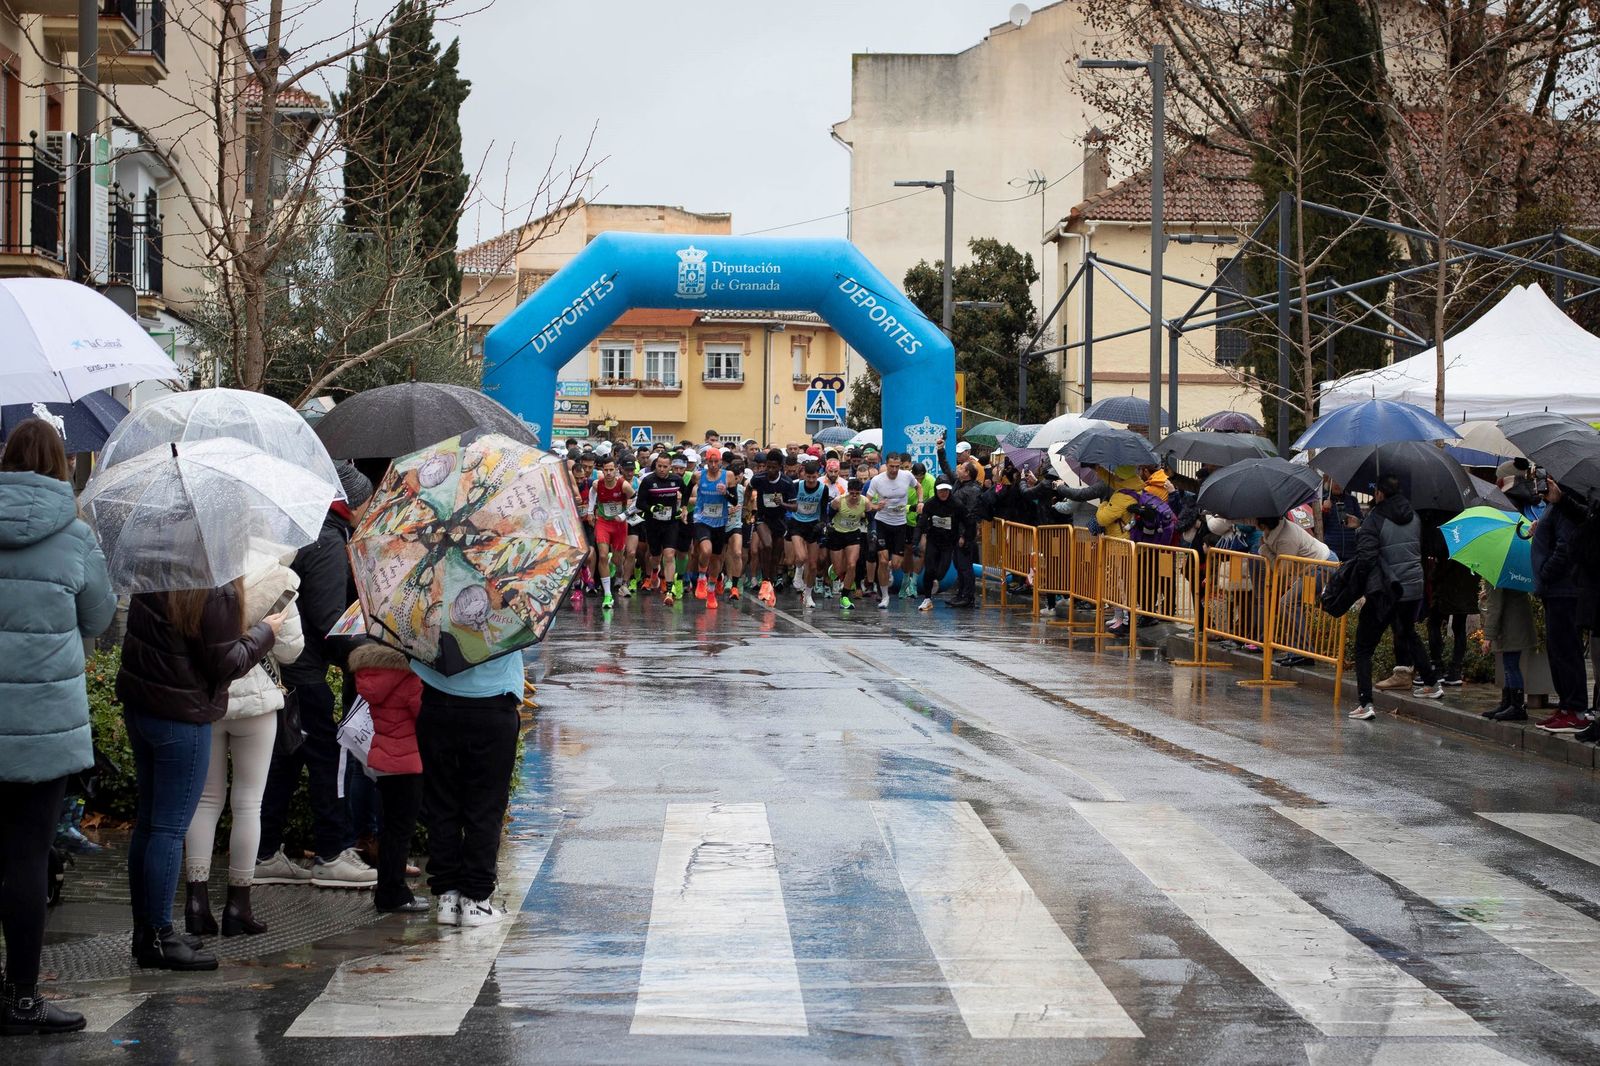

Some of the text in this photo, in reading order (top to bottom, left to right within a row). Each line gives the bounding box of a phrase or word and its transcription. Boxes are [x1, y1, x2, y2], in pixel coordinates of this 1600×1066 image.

[711, 260, 782, 276] Diputación
[711, 279, 780, 291] de Granada
[530, 273, 614, 354] DEPORTES
[838, 277, 923, 355] DEPORTES
